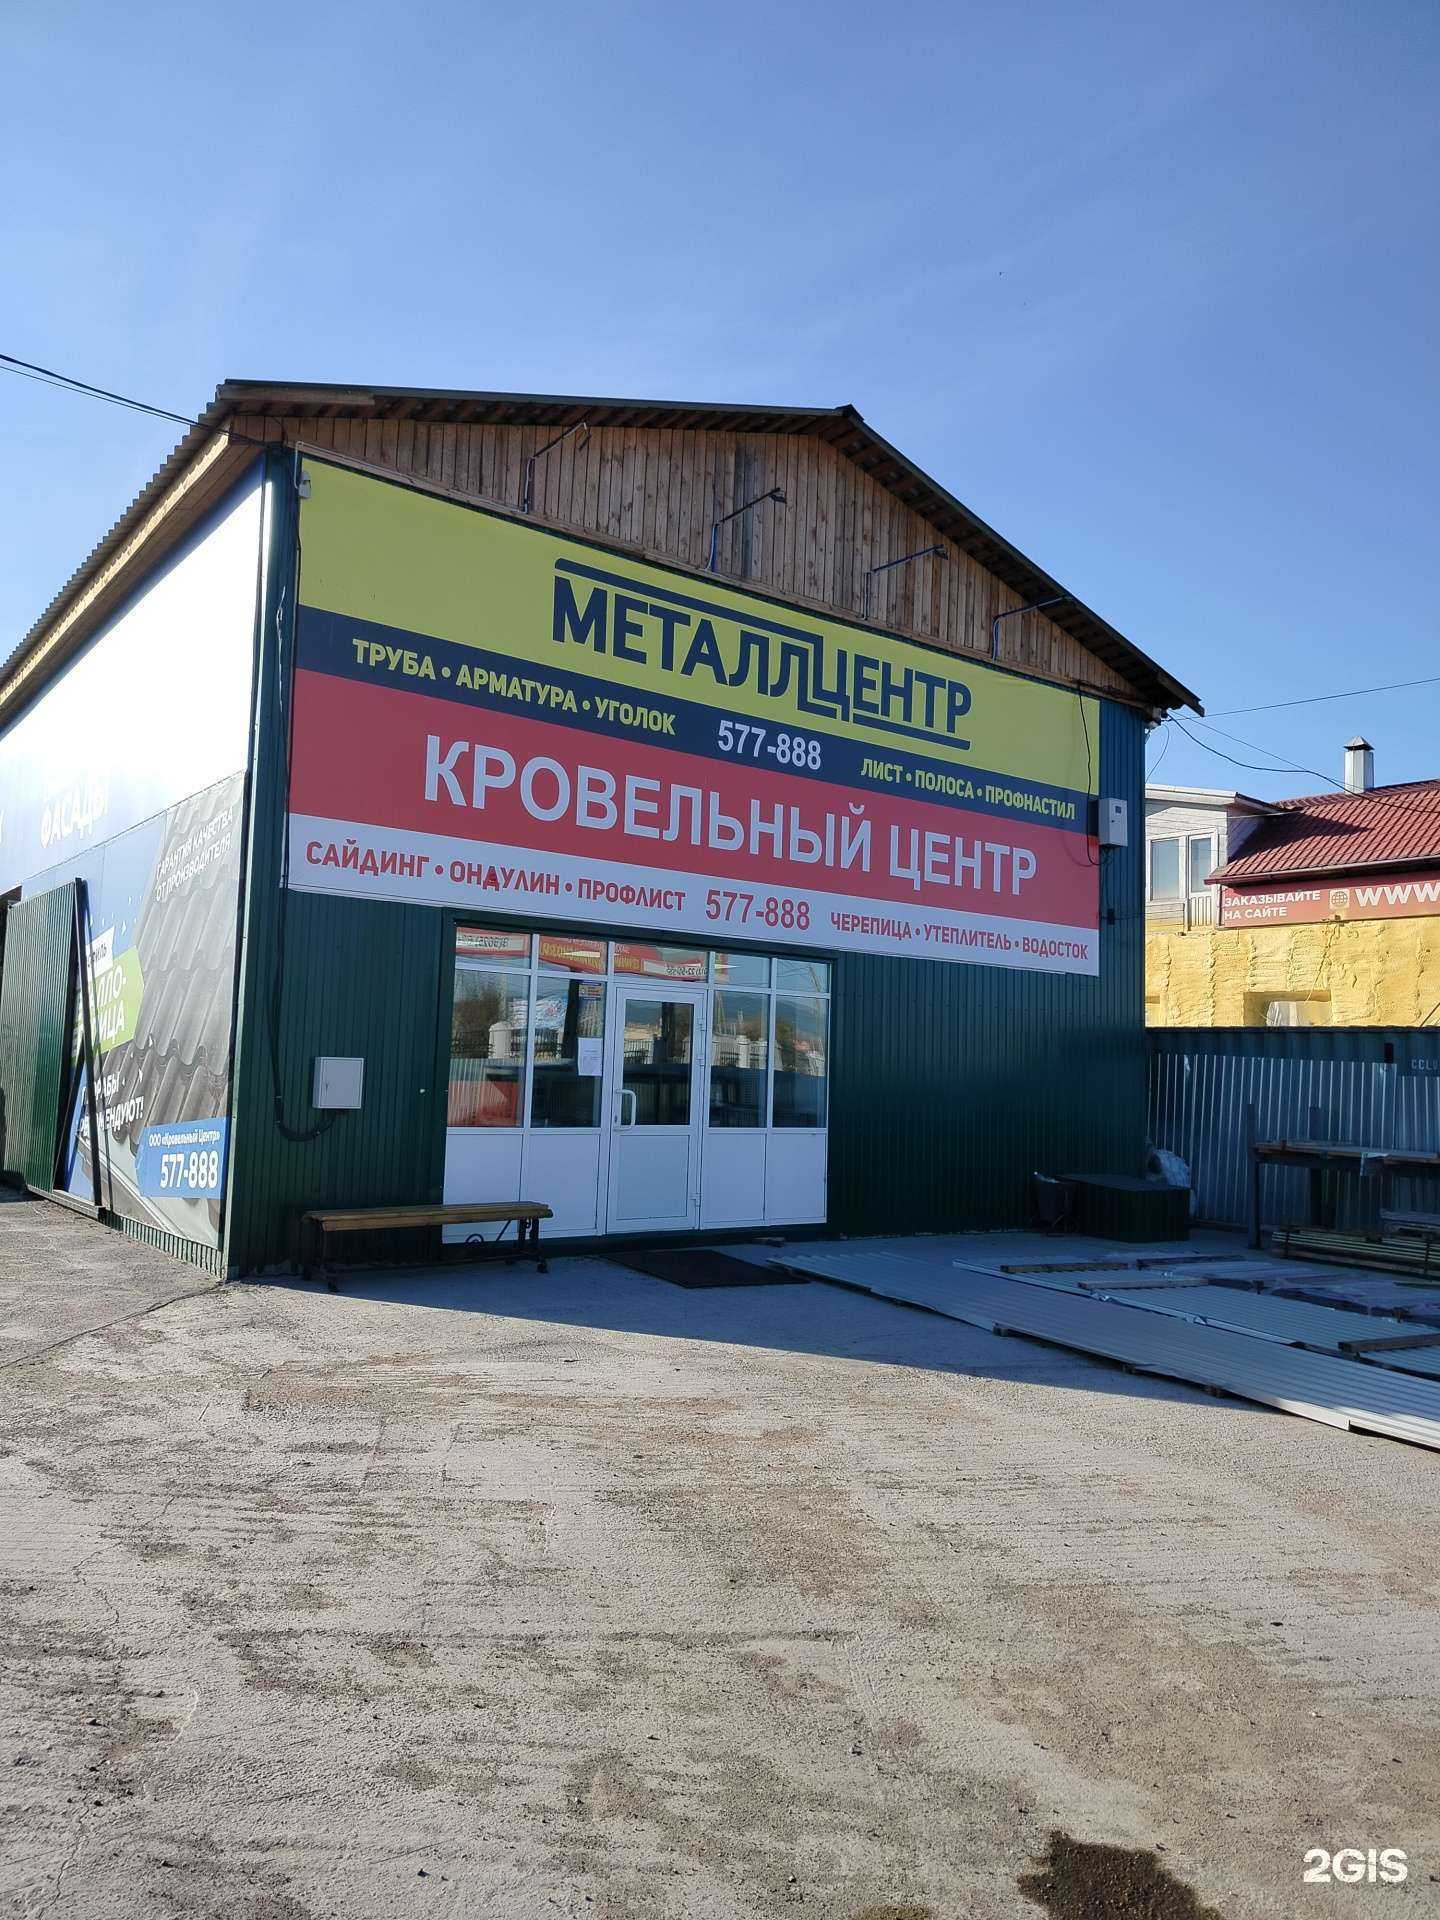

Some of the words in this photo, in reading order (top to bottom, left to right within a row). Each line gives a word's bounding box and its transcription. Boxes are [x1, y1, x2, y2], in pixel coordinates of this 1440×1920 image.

[552, 564, 972, 744] МЕТАЛЛЦЕНТР
[352, 638, 437, 681] ТРУБА
[455, 664, 578, 714] АРМАТУРА
[595, 696, 677, 736] УГОЛОК
[716, 719, 823, 771] 577-888
[423, 733, 872, 873] КРОВЕЛЬНЫЙ
[889, 824, 1038, 897] ЦЕНТР
[860, 758, 904, 786] ЛИСТ
[914, 769, 975, 800] ПОЛОСА
[984, 785, 1077, 820] ПРОФНАСТИЛ
[155, 879, 167, 902] ОТ
[167, 831, 232, 896] ПРОИЗВОДИТЕЛЯ
[157, 838, 192, 881] ГАРАНТИЯ
[192, 806, 234, 852] КАЧЕСТВА
[306, 838, 430, 879] САЙДИНГ
[449, 860, 560, 896] ОНДУЛИН
[577, 878, 687, 911] ПРОФЛИСТ
[1224, 889, 1321, 906] ЗАКАЗЫВАЙТЕ
[705, 889, 811, 931] 577-888
[831, 911, 912, 940] ЧЕРЕПИЦА
[923, 923, 1012, 951] УТЕПЛИТЕЛЬ
[1022, 936, 1089, 961] ВОДОСТОК
[1224, 910, 1241, 920] НА
[1243, 904, 1288, 919] САЙТЕ
[148, 1132, 162, 1147] ООО
[159, 1150, 219, 1189] 577-888
